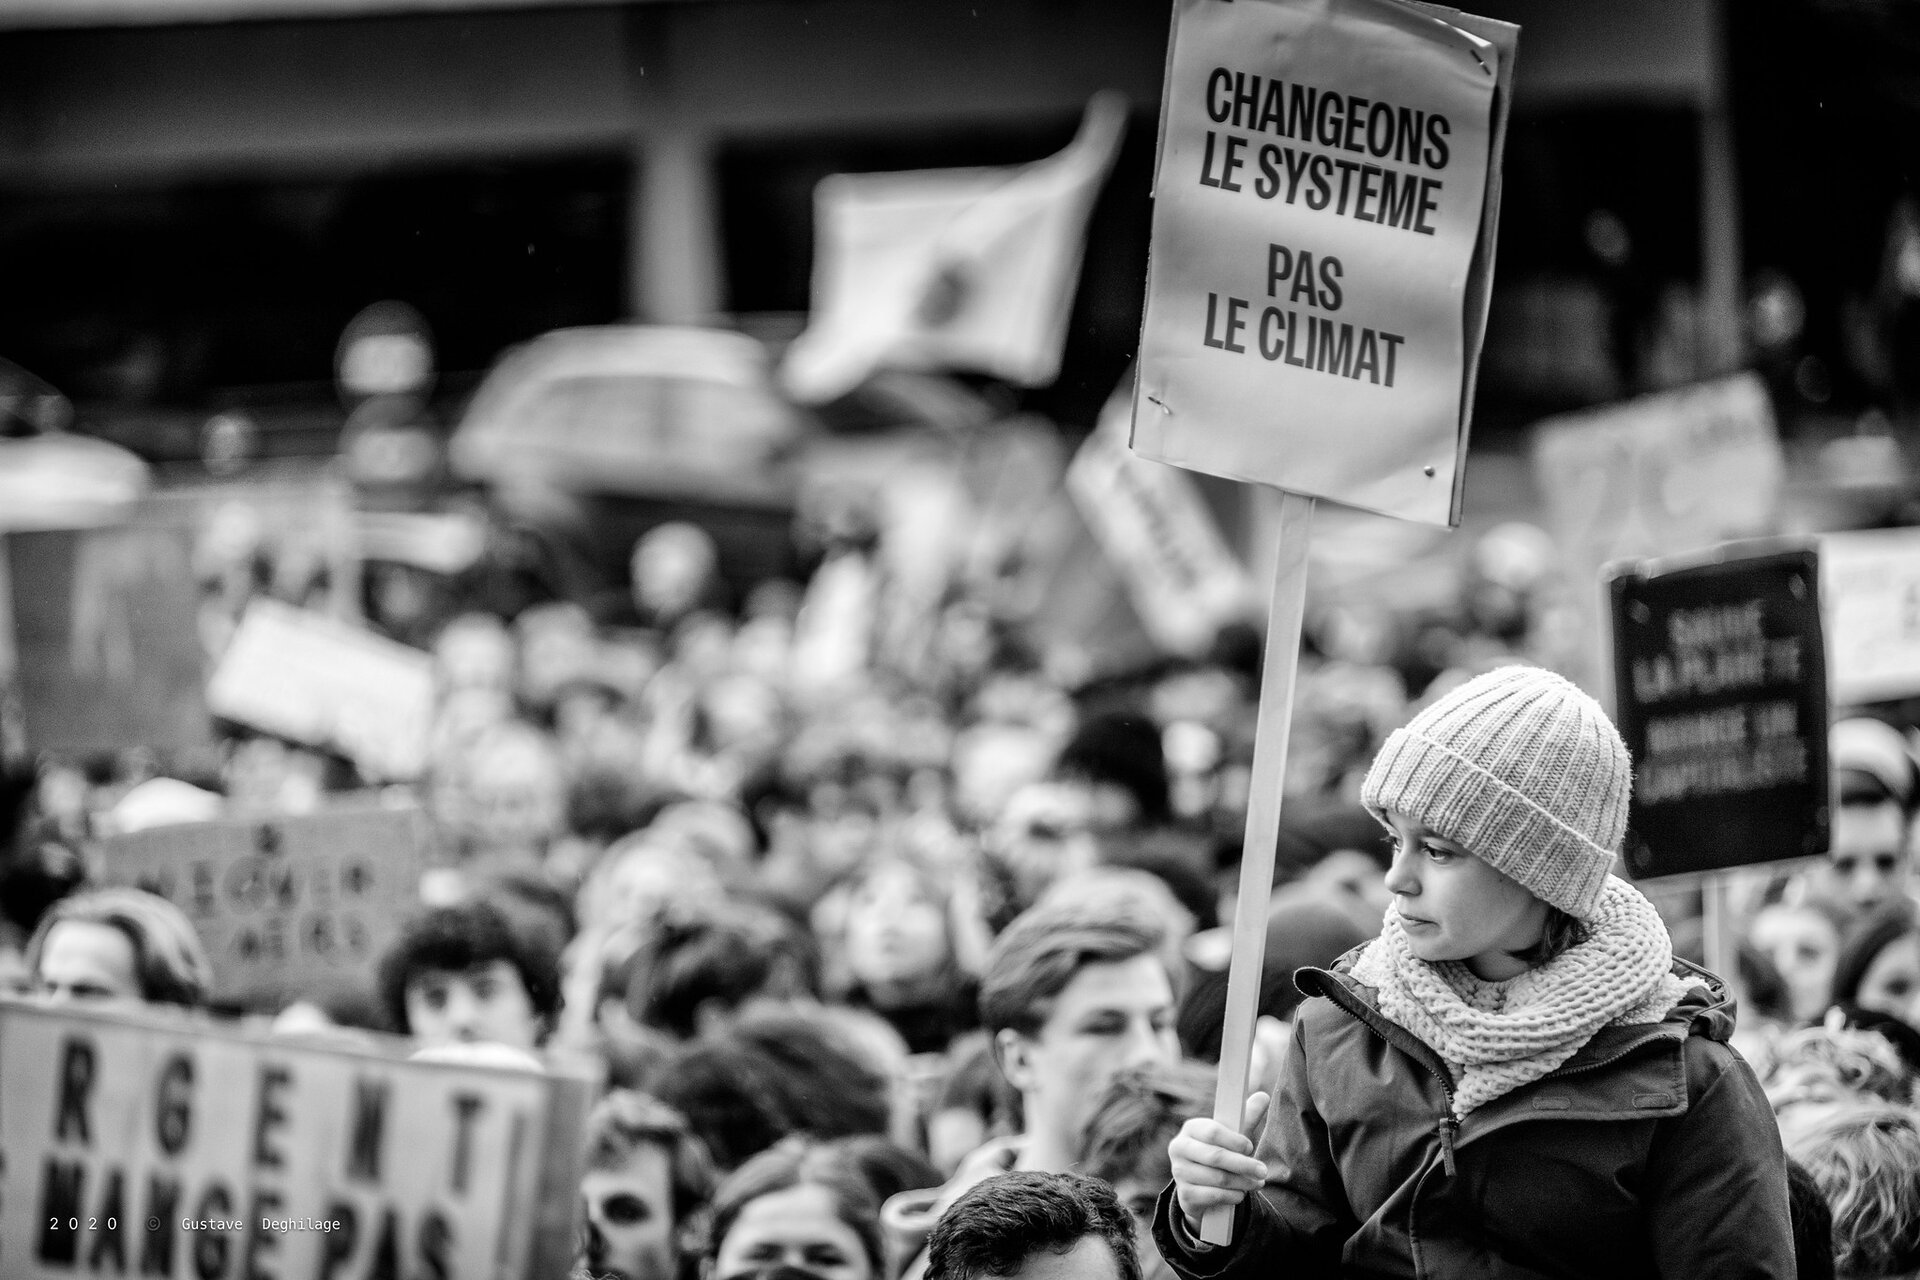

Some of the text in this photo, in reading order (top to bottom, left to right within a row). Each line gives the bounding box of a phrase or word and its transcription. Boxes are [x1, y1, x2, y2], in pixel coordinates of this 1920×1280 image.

[1205, 66, 1451, 170] CHANGEONS
[1199, 130, 1248, 193] LE
[1267, 243, 1343, 311] PAS
[1203, 292, 1405, 388] LE CLIMAT
